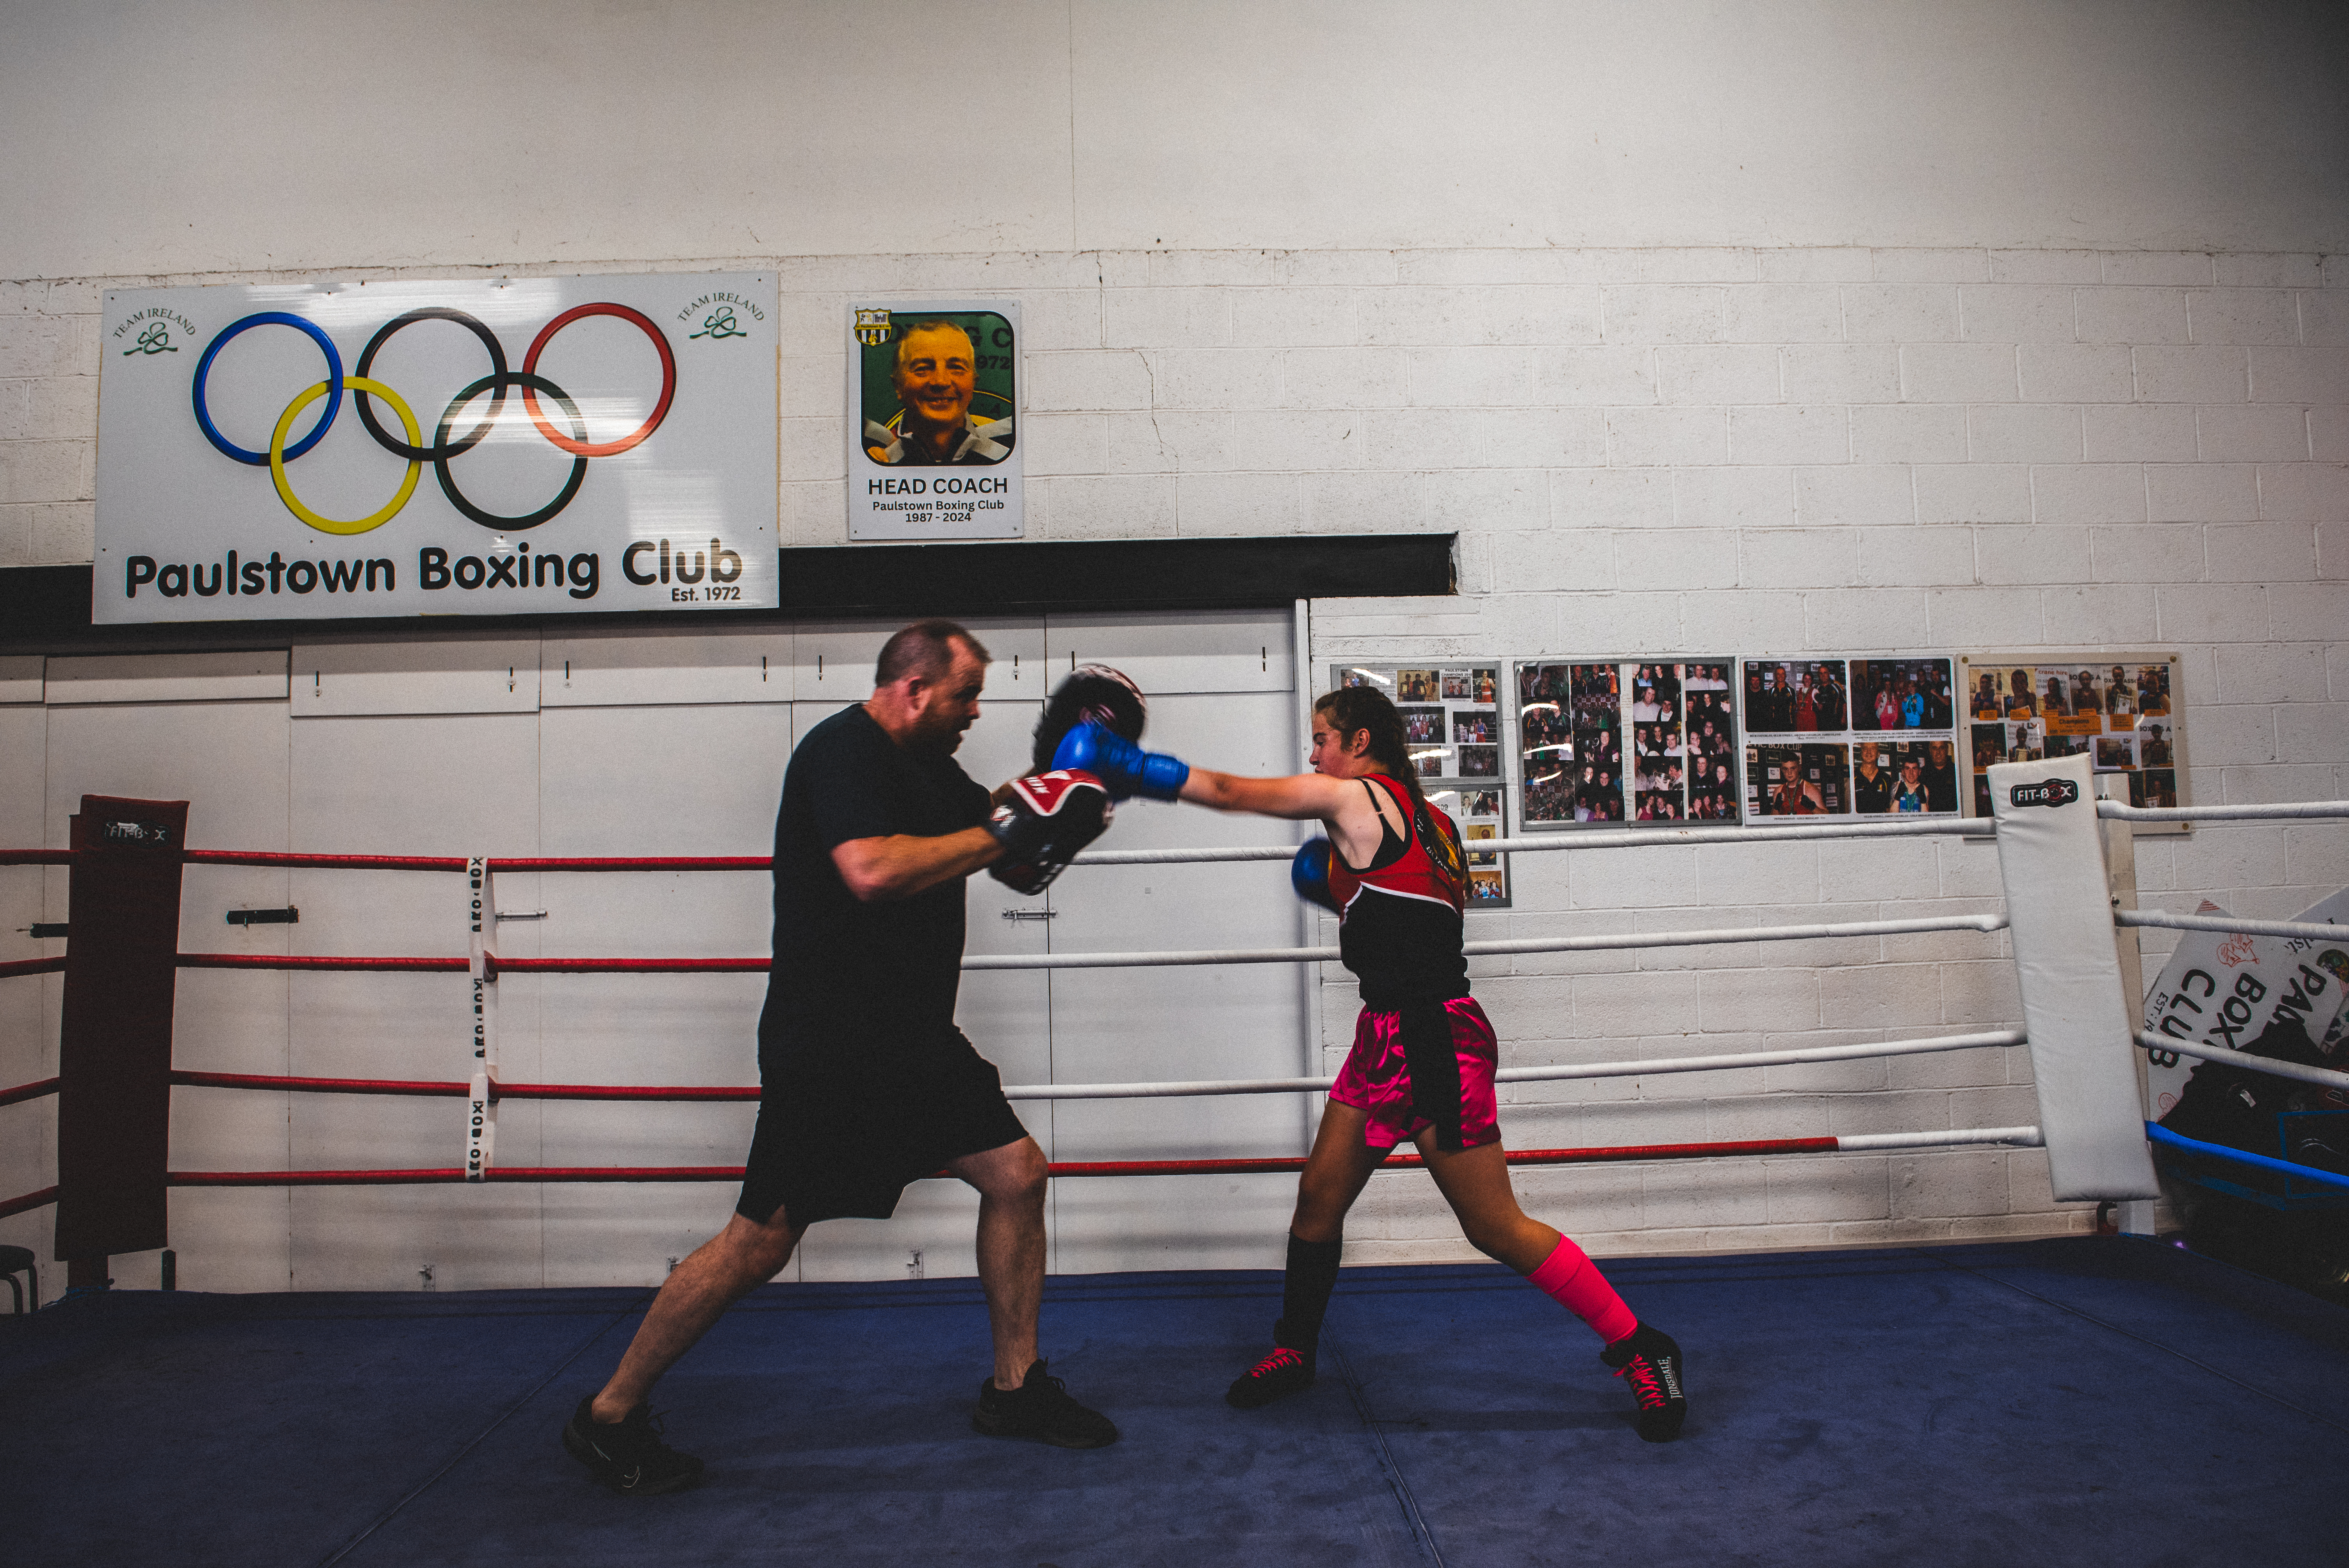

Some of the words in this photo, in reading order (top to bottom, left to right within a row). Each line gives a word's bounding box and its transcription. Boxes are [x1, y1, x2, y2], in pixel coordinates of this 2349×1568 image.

[677, 295, 709, 321] TEAM
[713, 292, 764, 321] IRELAND
[113, 311, 144, 337] TEAM
[147, 308, 195, 335] IRELAND
[976, 355, 1010, 369] 972
[868, 479, 927, 495] HEAD
[933, 478, 1007, 494] COACH
[873, 501, 932, 510] Paulstown
[936, 500, 975, 512] Boxing
[978, 499, 1004, 509] Club
[905, 513, 932, 522] 1987
[943, 512, 971, 522] 2024
[126, 549, 395, 598] Paulstown
[419, 542, 600, 599] Boxing
[622, 537, 742, 585] Club
[672, 588, 699, 601] Est.
[705, 587, 740, 600] 1972
[2018, 786, 2071, 801] FIT-BOX
[2144, 1019, 2155, 1032] 19
[2148, 969, 2216, 1069] CLUB
[1657, 1356, 1683, 1399] LONSDALE
